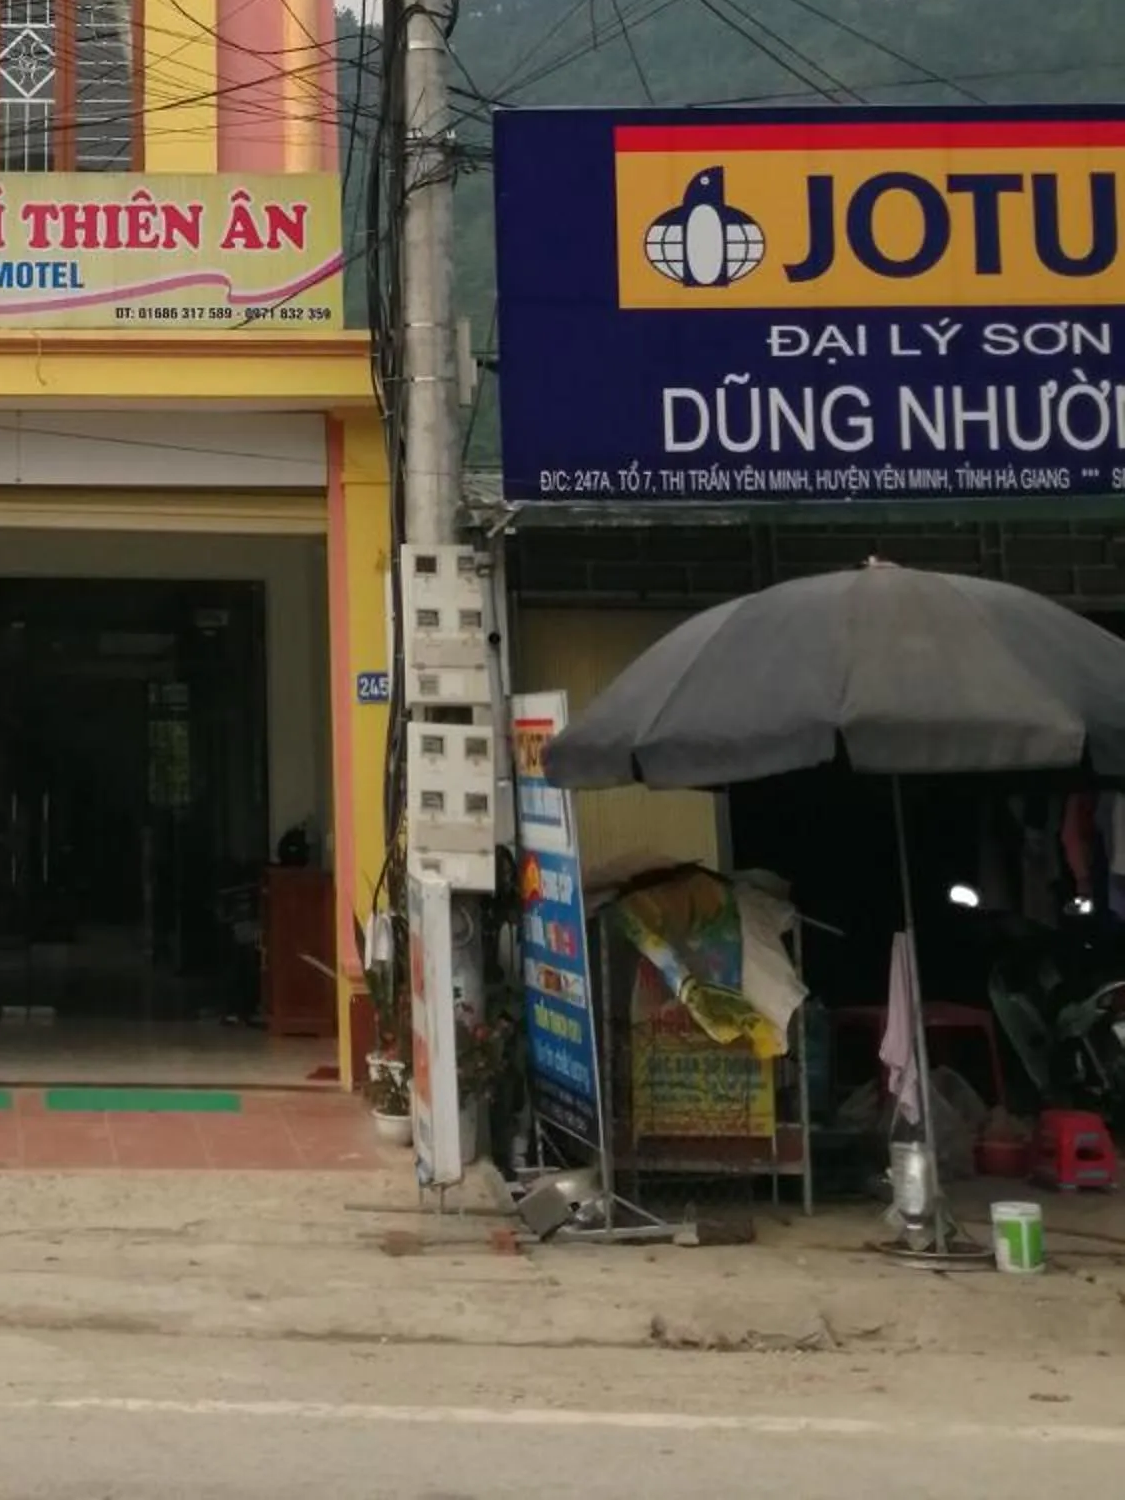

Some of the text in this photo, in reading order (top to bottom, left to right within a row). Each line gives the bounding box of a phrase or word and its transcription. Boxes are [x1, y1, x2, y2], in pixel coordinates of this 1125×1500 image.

[21, 189, 203, 249] THIÊN
[220, 190, 308, 250] ÂN
[783, 171, 1118, 283] JOTU
[181, 307, 205, 320] 317
[766, 317, 1112, 365] ĐẠI LÝ SƠN
[662, 367, 1125, 453] DŨNG NHƯỜ
[574, 469, 616, 494] 247A,
[617, 459, 640, 492] TỔ
[642, 470, 657, 493] 7,
[732, 464, 767, 492] YÊN
[768, 469, 814, 493] MINH,
[872, 463, 907, 491] YÊN
[908, 468, 953, 493] MINH,
[994, 462, 1019, 491] HÀ
[1020, 467, 1071, 490] GIANG
